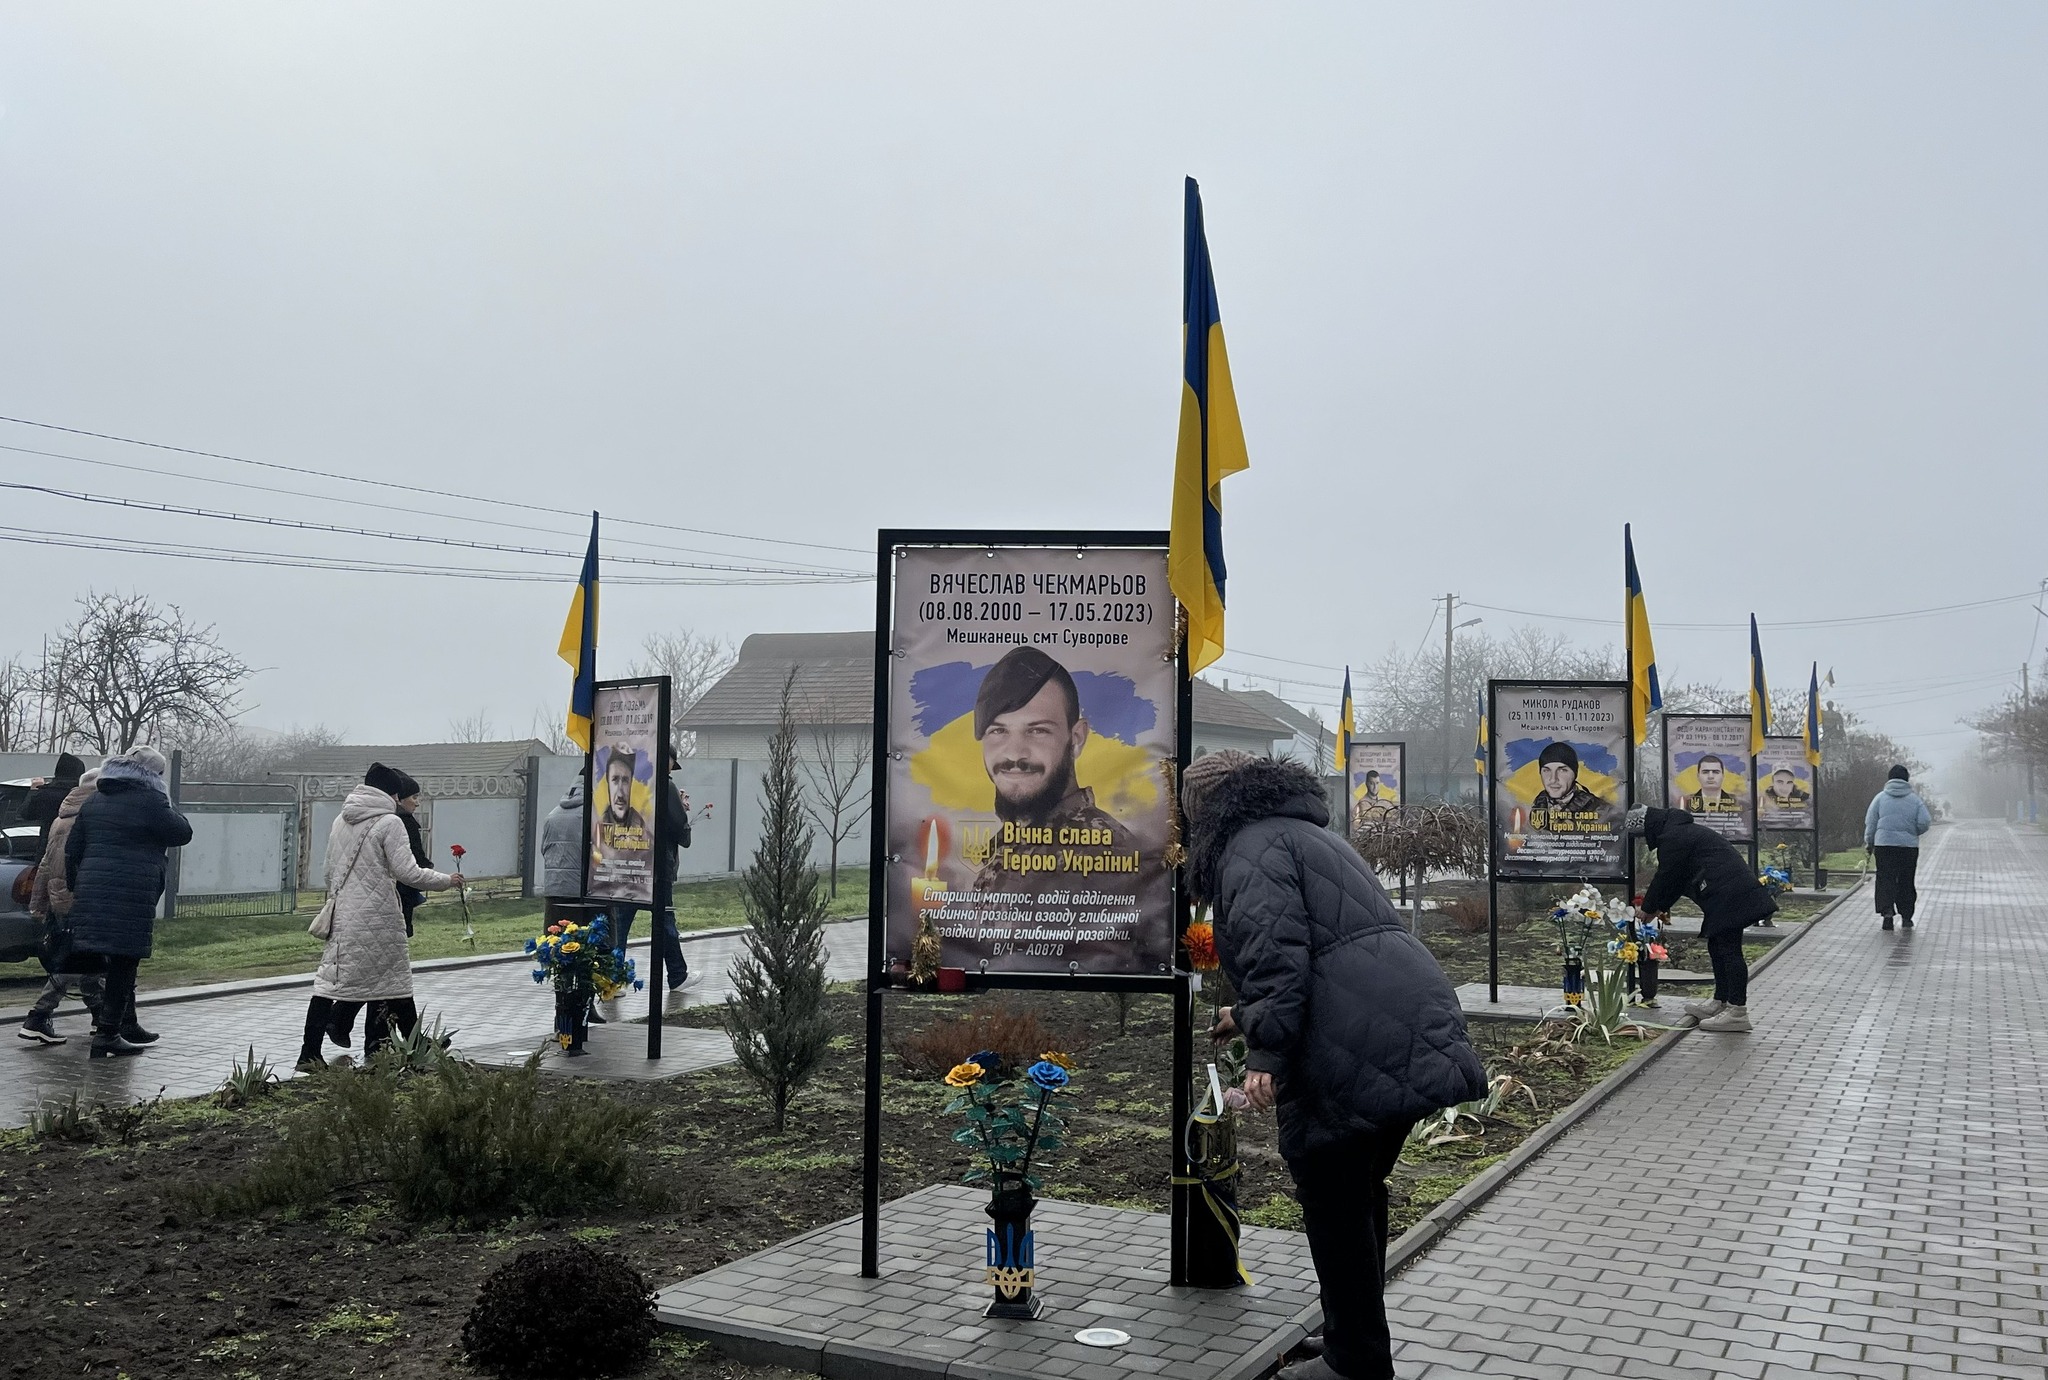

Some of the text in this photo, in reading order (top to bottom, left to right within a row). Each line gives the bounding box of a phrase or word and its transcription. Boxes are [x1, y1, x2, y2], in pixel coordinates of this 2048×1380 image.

[930, 574, 1146, 595] ВЯЧЕСЛАВ ЧЕКМАРЬОВ
[919, 601, 1022, 622] (08.08.2000
[1050, 602, 1153, 624] 17.05.2023)
[947, 628, 1129, 648] Мешканець смт Суворове
[1522, 699, 1601, 710] МИКОЛА РУДАКОВ
[1521, 723, 1559, 731] Мешканець
[1573, 724, 1605, 733] Суворове
[1549, 809, 1599, 820] Вічна слава
[1003, 821, 1113, 846] Вічна слава
[1549, 821, 1611, 833] Герою України!
[1003, 849, 1140, 876] Герою України!
[924, 887, 1136, 907] Старший матрос, водій відділення
[919, 905, 1141, 926] глибинної розвідки взводу глибинної
[936, 924, 1131, 943] звідки роти глибинної розвідки.
[993, 943, 1013, 956] В/Ч
